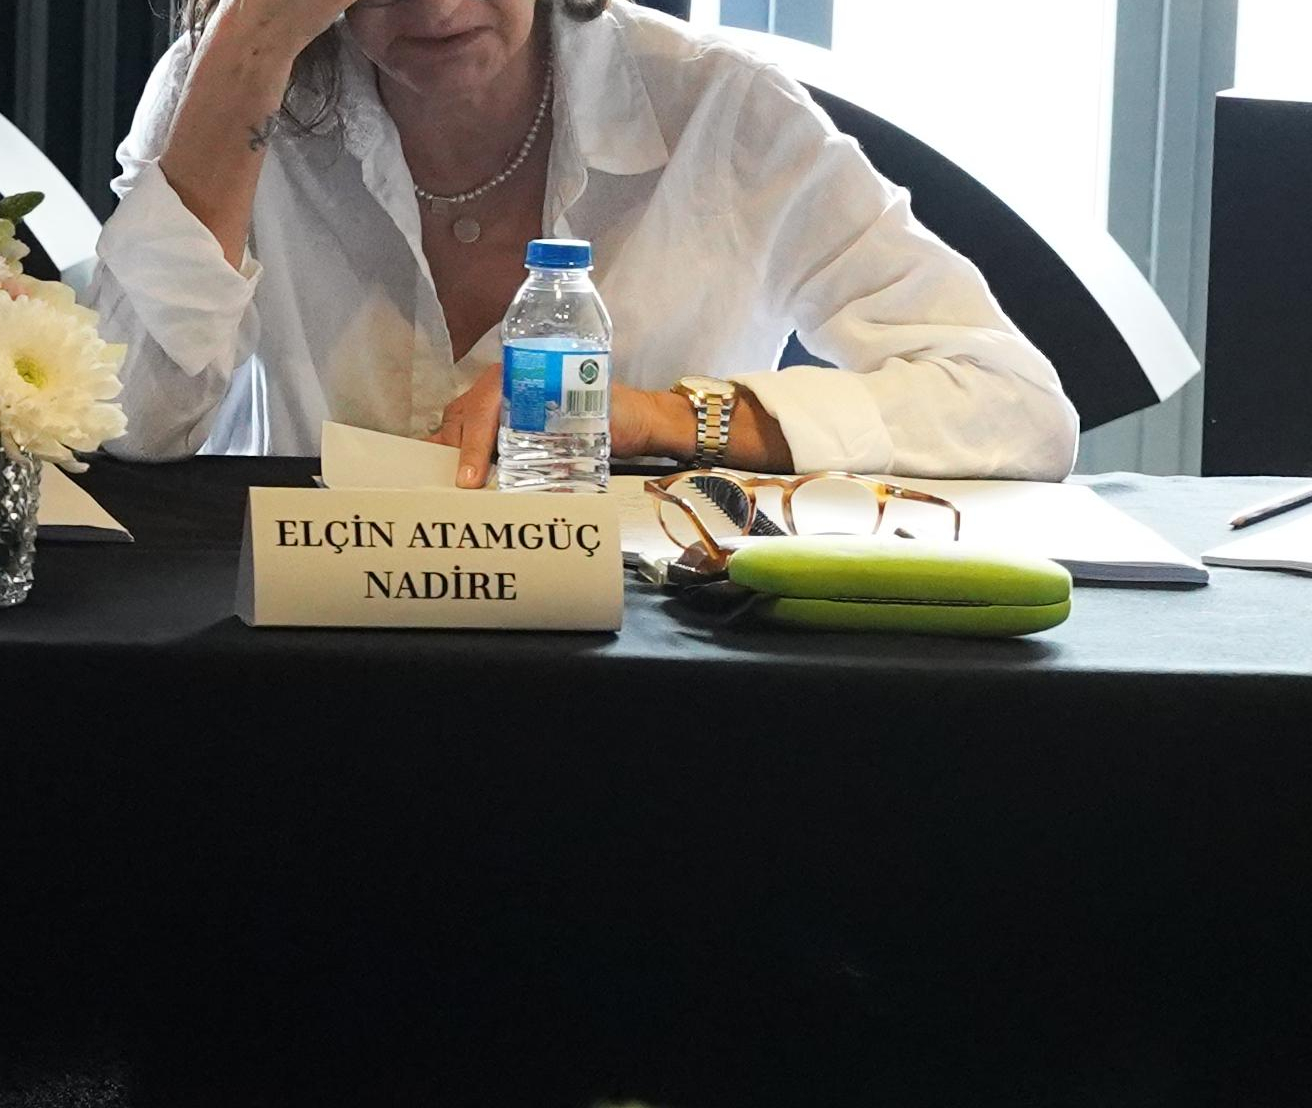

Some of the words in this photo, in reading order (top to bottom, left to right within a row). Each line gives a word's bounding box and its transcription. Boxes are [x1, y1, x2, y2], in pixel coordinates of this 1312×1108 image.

[274, 514, 395, 556] ELÇİN
[407, 517, 602, 558] ATAMGÜÇ
[363, 564, 518, 600] NADİRE
